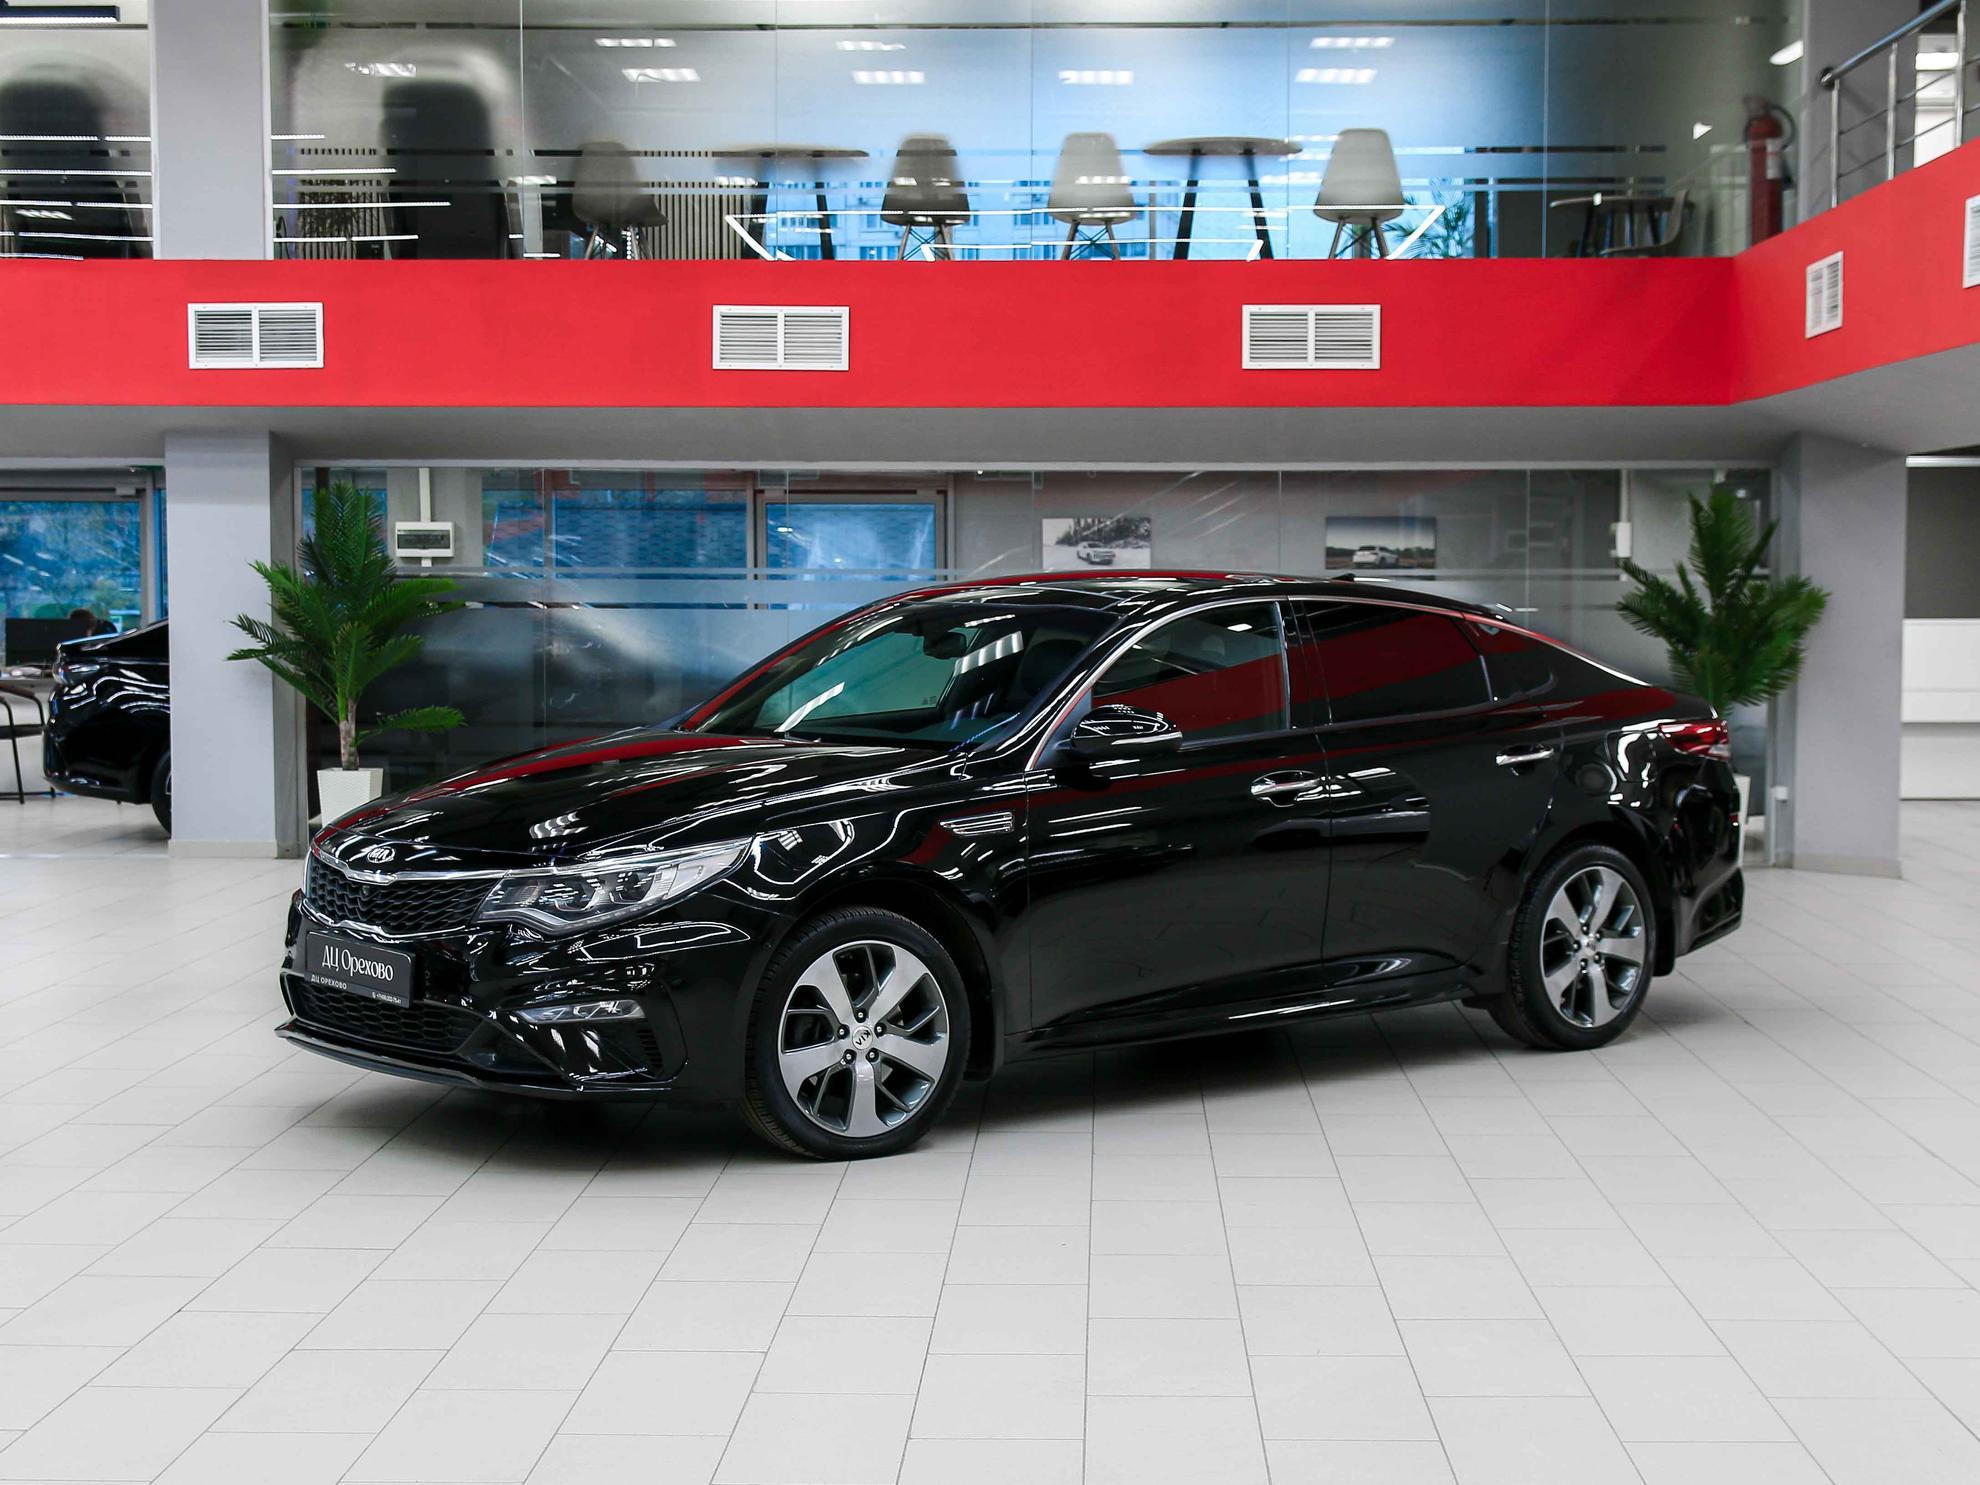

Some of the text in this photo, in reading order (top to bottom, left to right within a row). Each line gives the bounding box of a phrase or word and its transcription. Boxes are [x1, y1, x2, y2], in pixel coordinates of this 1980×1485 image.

[322, 945, 394, 981] ДЦ Орехово
[311, 974, 347, 990] ДЦ ОРЕХОВО
[855, 1030, 871, 1046] KIA
